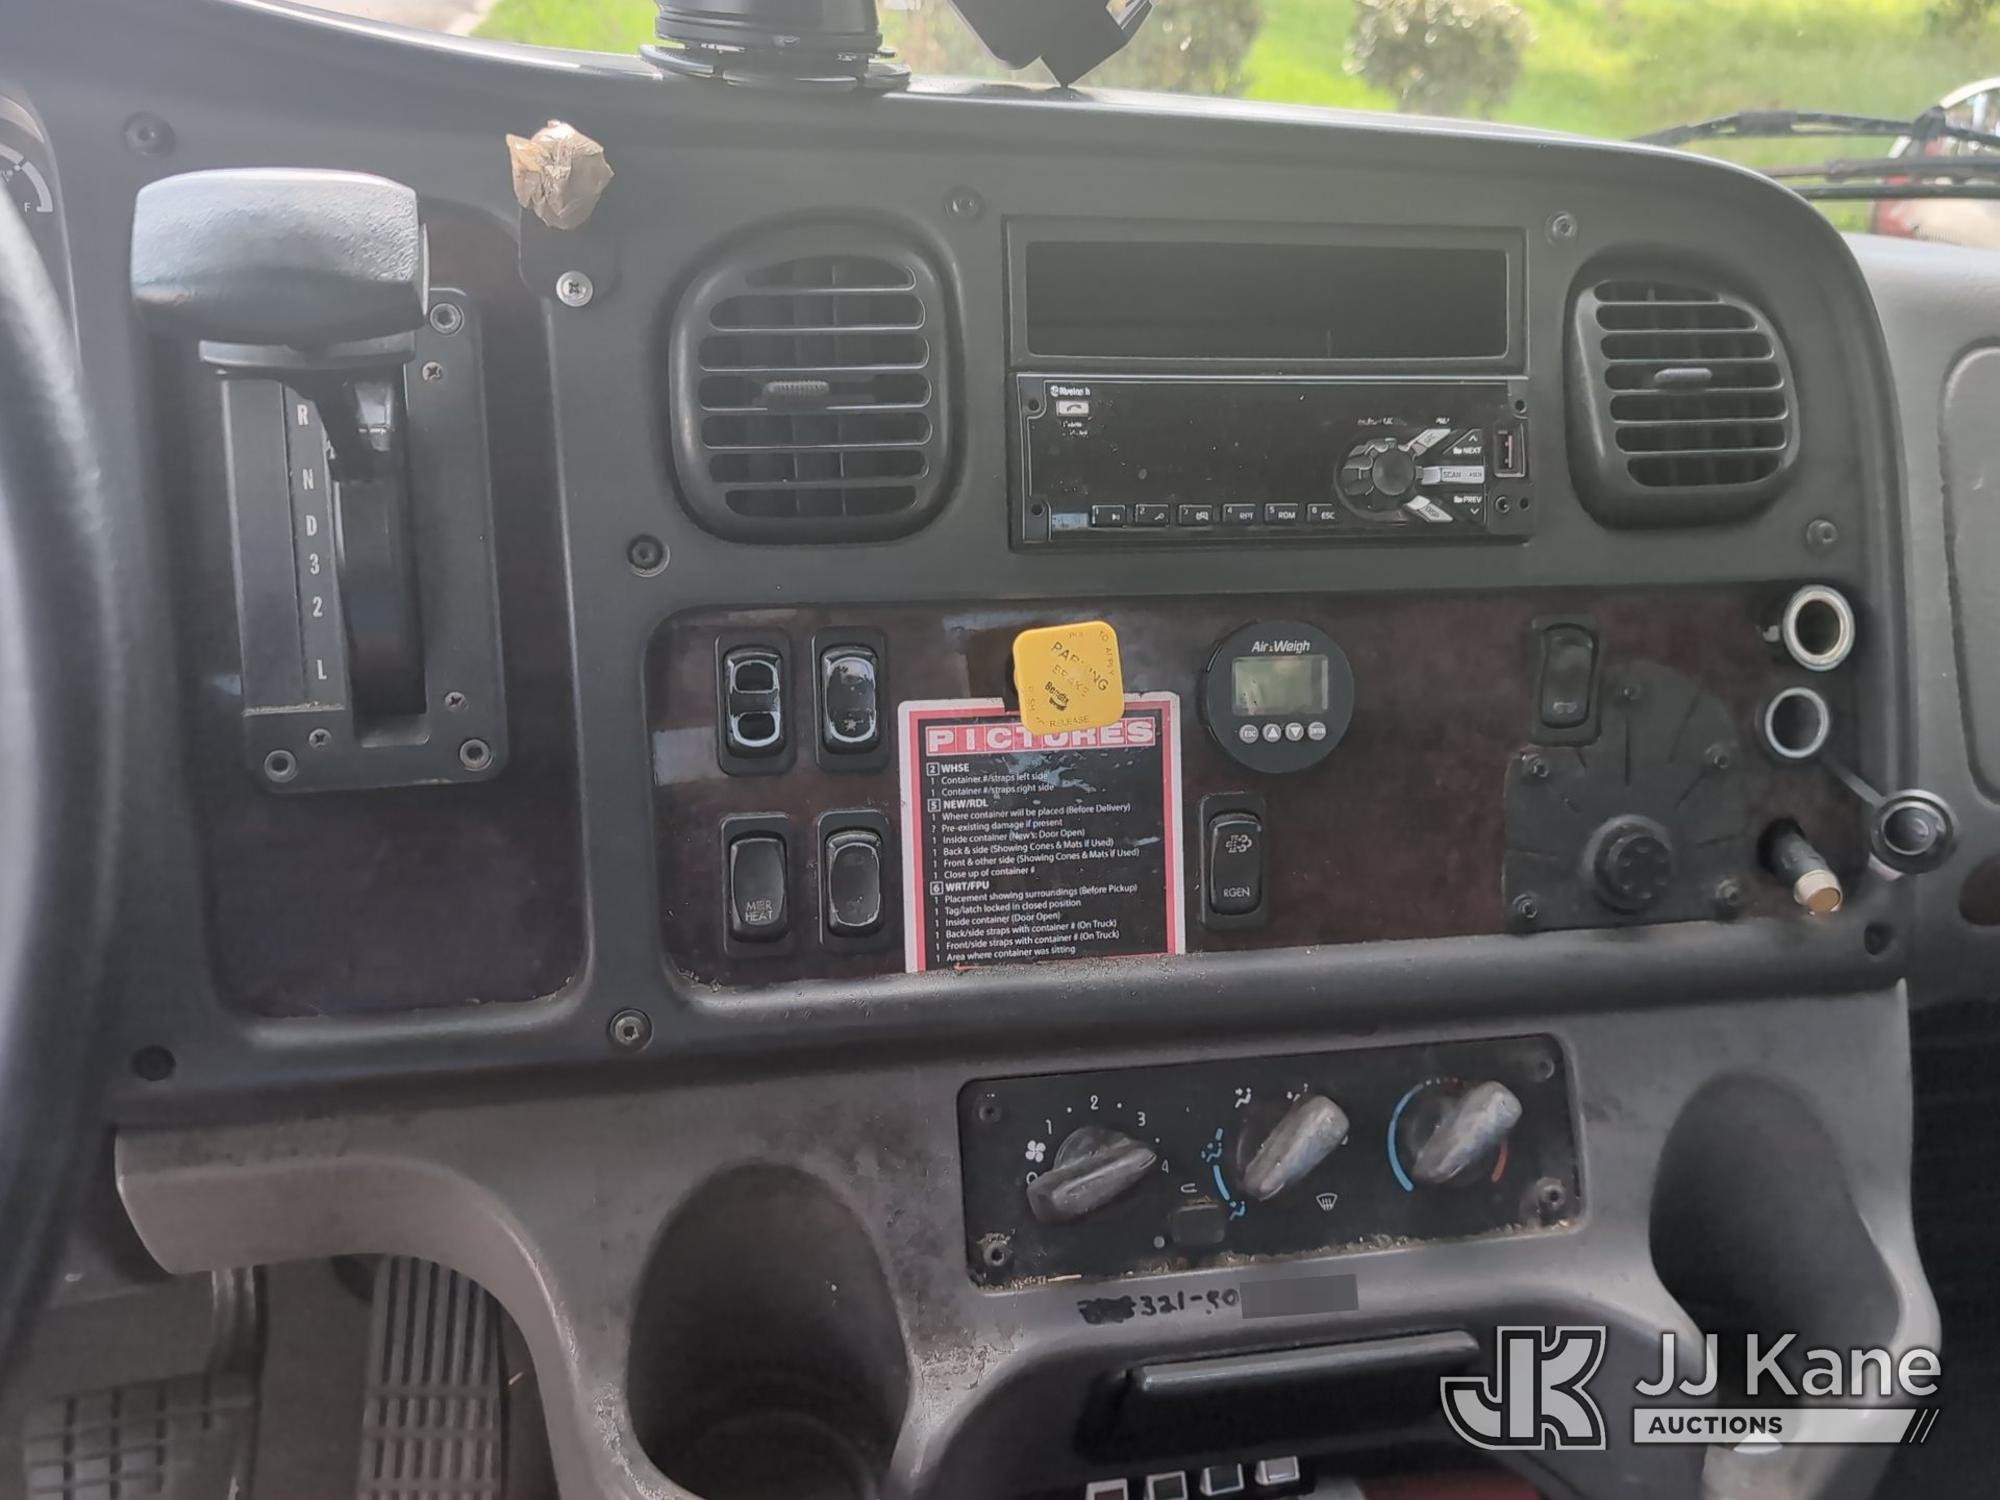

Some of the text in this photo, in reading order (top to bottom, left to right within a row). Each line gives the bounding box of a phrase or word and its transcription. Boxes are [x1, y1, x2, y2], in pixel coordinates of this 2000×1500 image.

[24, 202, 31, 212] F
[297, 404, 309, 426] R
[1462, 446, 1482, 454] NEXT
[302, 468, 314, 490] N
[306, 514, 318, 537] D
[310, 553, 320, 575] 3
[313, 596, 323, 617] 2
[317, 659, 327, 680] L
[929, 721, 1153, 752] PICTURES
[940, 762, 970, 773] WHSE
[940, 774, 982, 786] Container
[1030, 770, 1048, 780] side
[941, 786, 982, 797] Container
[1016, 783, 1036, 794] right
[1038, 782, 1054, 791] side
[940, 811, 968, 822] Where
[970, 809, 1008, 820] container
[1010, 808, 1024, 817] will
[1026, 807, 1036, 816] be
[1037, 805, 1064, 817] placed
[1066, 804, 1094, 815] (Before
[1095, 801, 1130, 814] Delivery)
[942, 798, 988, 810] NEW/RDL
[940, 822, 990, 835] Pre-existing
[990, 819, 1024, 832] damage
[1025, 819, 1031, 828] if
[1032, 817, 1062, 829] present
[942, 834, 968, 844] Inside
[968, 832, 1007, 842] container
[1038, 829, 1058, 838] Door
[1060, 827, 1086, 838] Open)
[942, 847, 962, 856] Back
[972, 845, 988, 854] side
[990, 843, 1028, 855] (Showing
[1028, 841, 1054, 851] Cones
[1062, 839, 1082, 848] Mats
[1084, 839, 1090, 847] if
[1090, 837, 1114, 848] Used)
[943, 859, 966, 867] Front
[974, 857, 996, 865] other
[998, 855, 1015, 864] side
[1016, 853, 1054, 865] (Showing
[1054, 851, 1080, 860] Cones
[1088, 850, 1108, 858] Mats
[1109, 849, 1116, 857] if
[1116, 848, 1140, 858] Used)
[944, 870, 964, 879] Close
[966, 869, 978, 879] up
[979, 868, 989, 877] of
[990, 866, 1028, 876] container
[944, 880, 990, 892] WRT/FPU
[944, 892, 987, 903] Placement
[988, 890, 1024, 902] showing
[1024, 887, 1077, 900] surroundings
[1078, 885, 1106, 896] (Before
[1108, 883, 1138, 894] Pickup)
[1223, 887, 1250, 898] RGEN
[982, 903, 1010, 912] locked
[1011, 902, 1020, 910] in
[1048, 898, 1082, 910] position
[945, 917, 970, 926] Inside
[970, 915, 1010, 925] container
[1010, 913, 1034, 924] (Door
[1035, 912, 1060, 922] Open)
[945, 928, 984, 938] Back/side
[985, 926, 1010, 937] straps
[1011, 925, 1030, 934] with
[1030, 923, 1068, 933] container
[1076, 921, 1091, 932] (On
[1092, 920, 1116, 931] Truck)
[946, 939, 988, 950] Front/side
[988, 938, 1013, 949] straps
[1014, 936, 1032, 945] with
[1034, 934, 1072, 944] container
[1079, 933, 1094, 943] (On
[1095, 931, 1120, 942] Truck)
[946, 952, 965, 961] Area
[966, 950, 992, 960] where
[992, 948, 1032, 958] container
[1033, 948, 1050, 956] was
[1050, 945, 1076, 956] sitting
[1090, 1095, 1099, 1110] 2
[1137, 1111, 1146, 1126] 3
[1045, 1119, 1052, 1135] 1
[1161, 1159, 1170, 1173] 4
